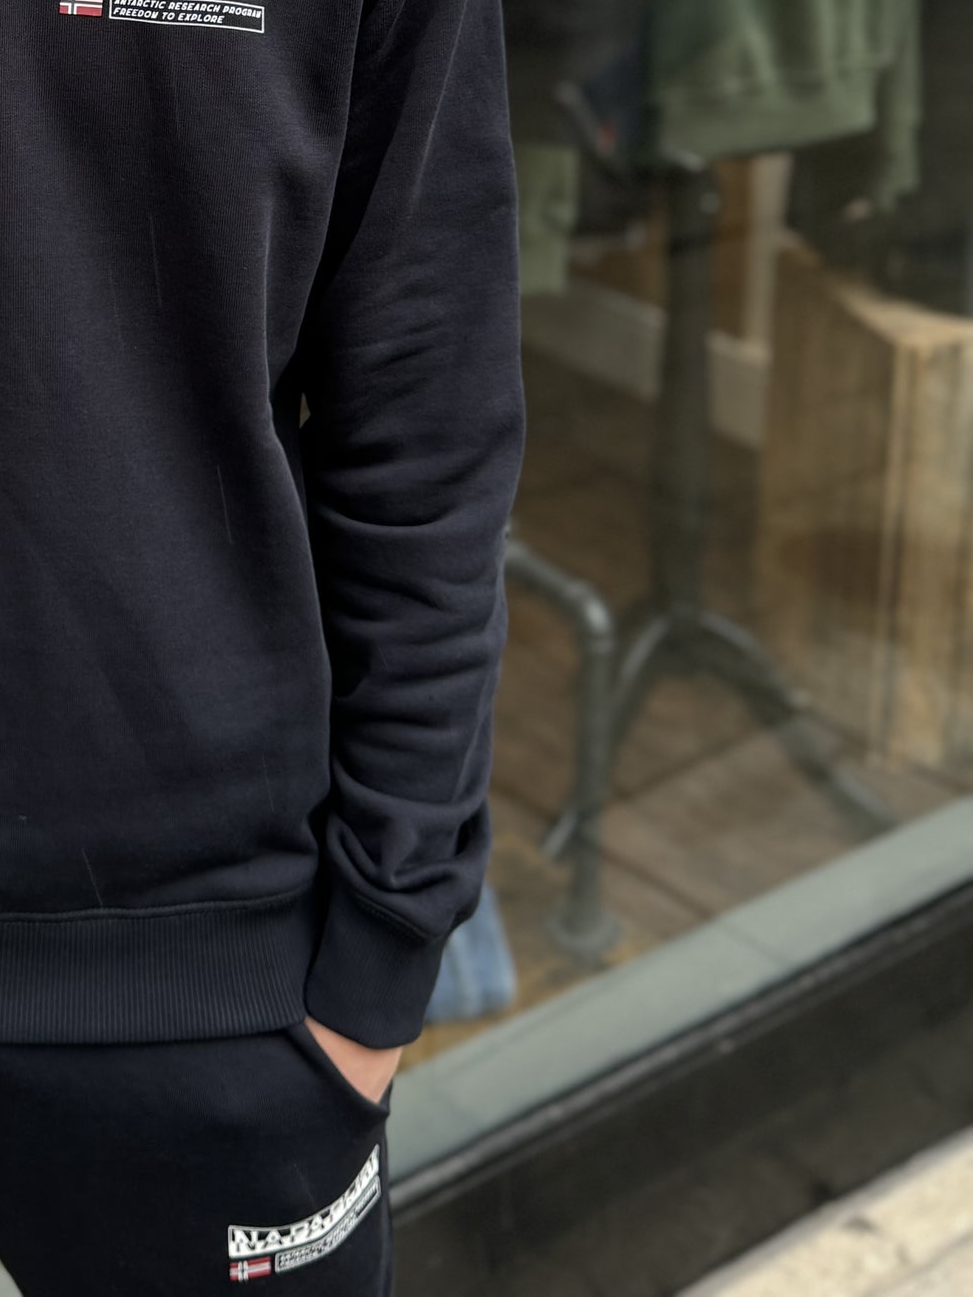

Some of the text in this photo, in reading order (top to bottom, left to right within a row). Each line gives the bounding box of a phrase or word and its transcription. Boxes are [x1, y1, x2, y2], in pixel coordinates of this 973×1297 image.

[113, 8, 225, 24] FREEDOM TO EXPLORE
[168, 2, 221, 12] RESEARCH
[222, 5, 262, 19] PROGRAM
